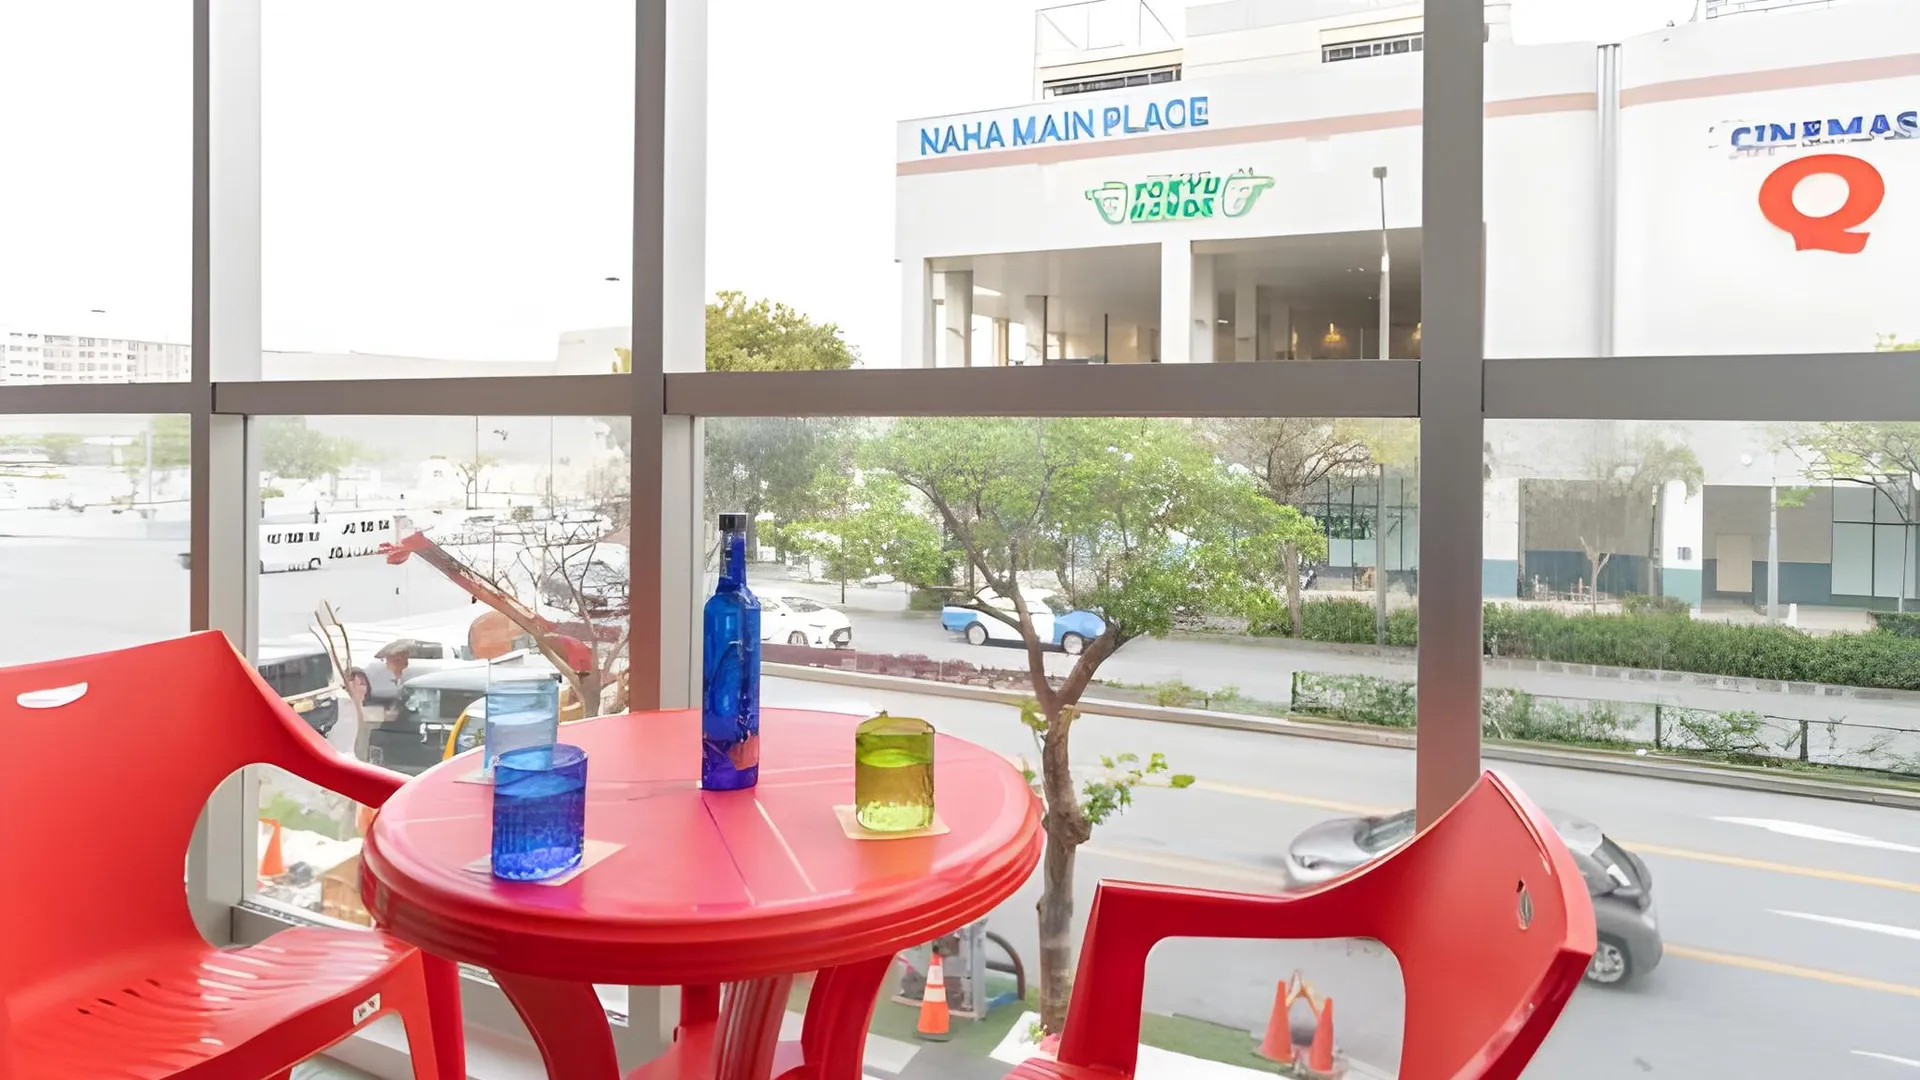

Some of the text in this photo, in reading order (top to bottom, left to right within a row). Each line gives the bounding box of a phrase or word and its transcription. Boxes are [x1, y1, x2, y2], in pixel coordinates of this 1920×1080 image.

[921, 121, 1005, 155] NAHA
[1012, 109, 1095, 146] MAIN
[1758, 153, 1885, 254] Q
